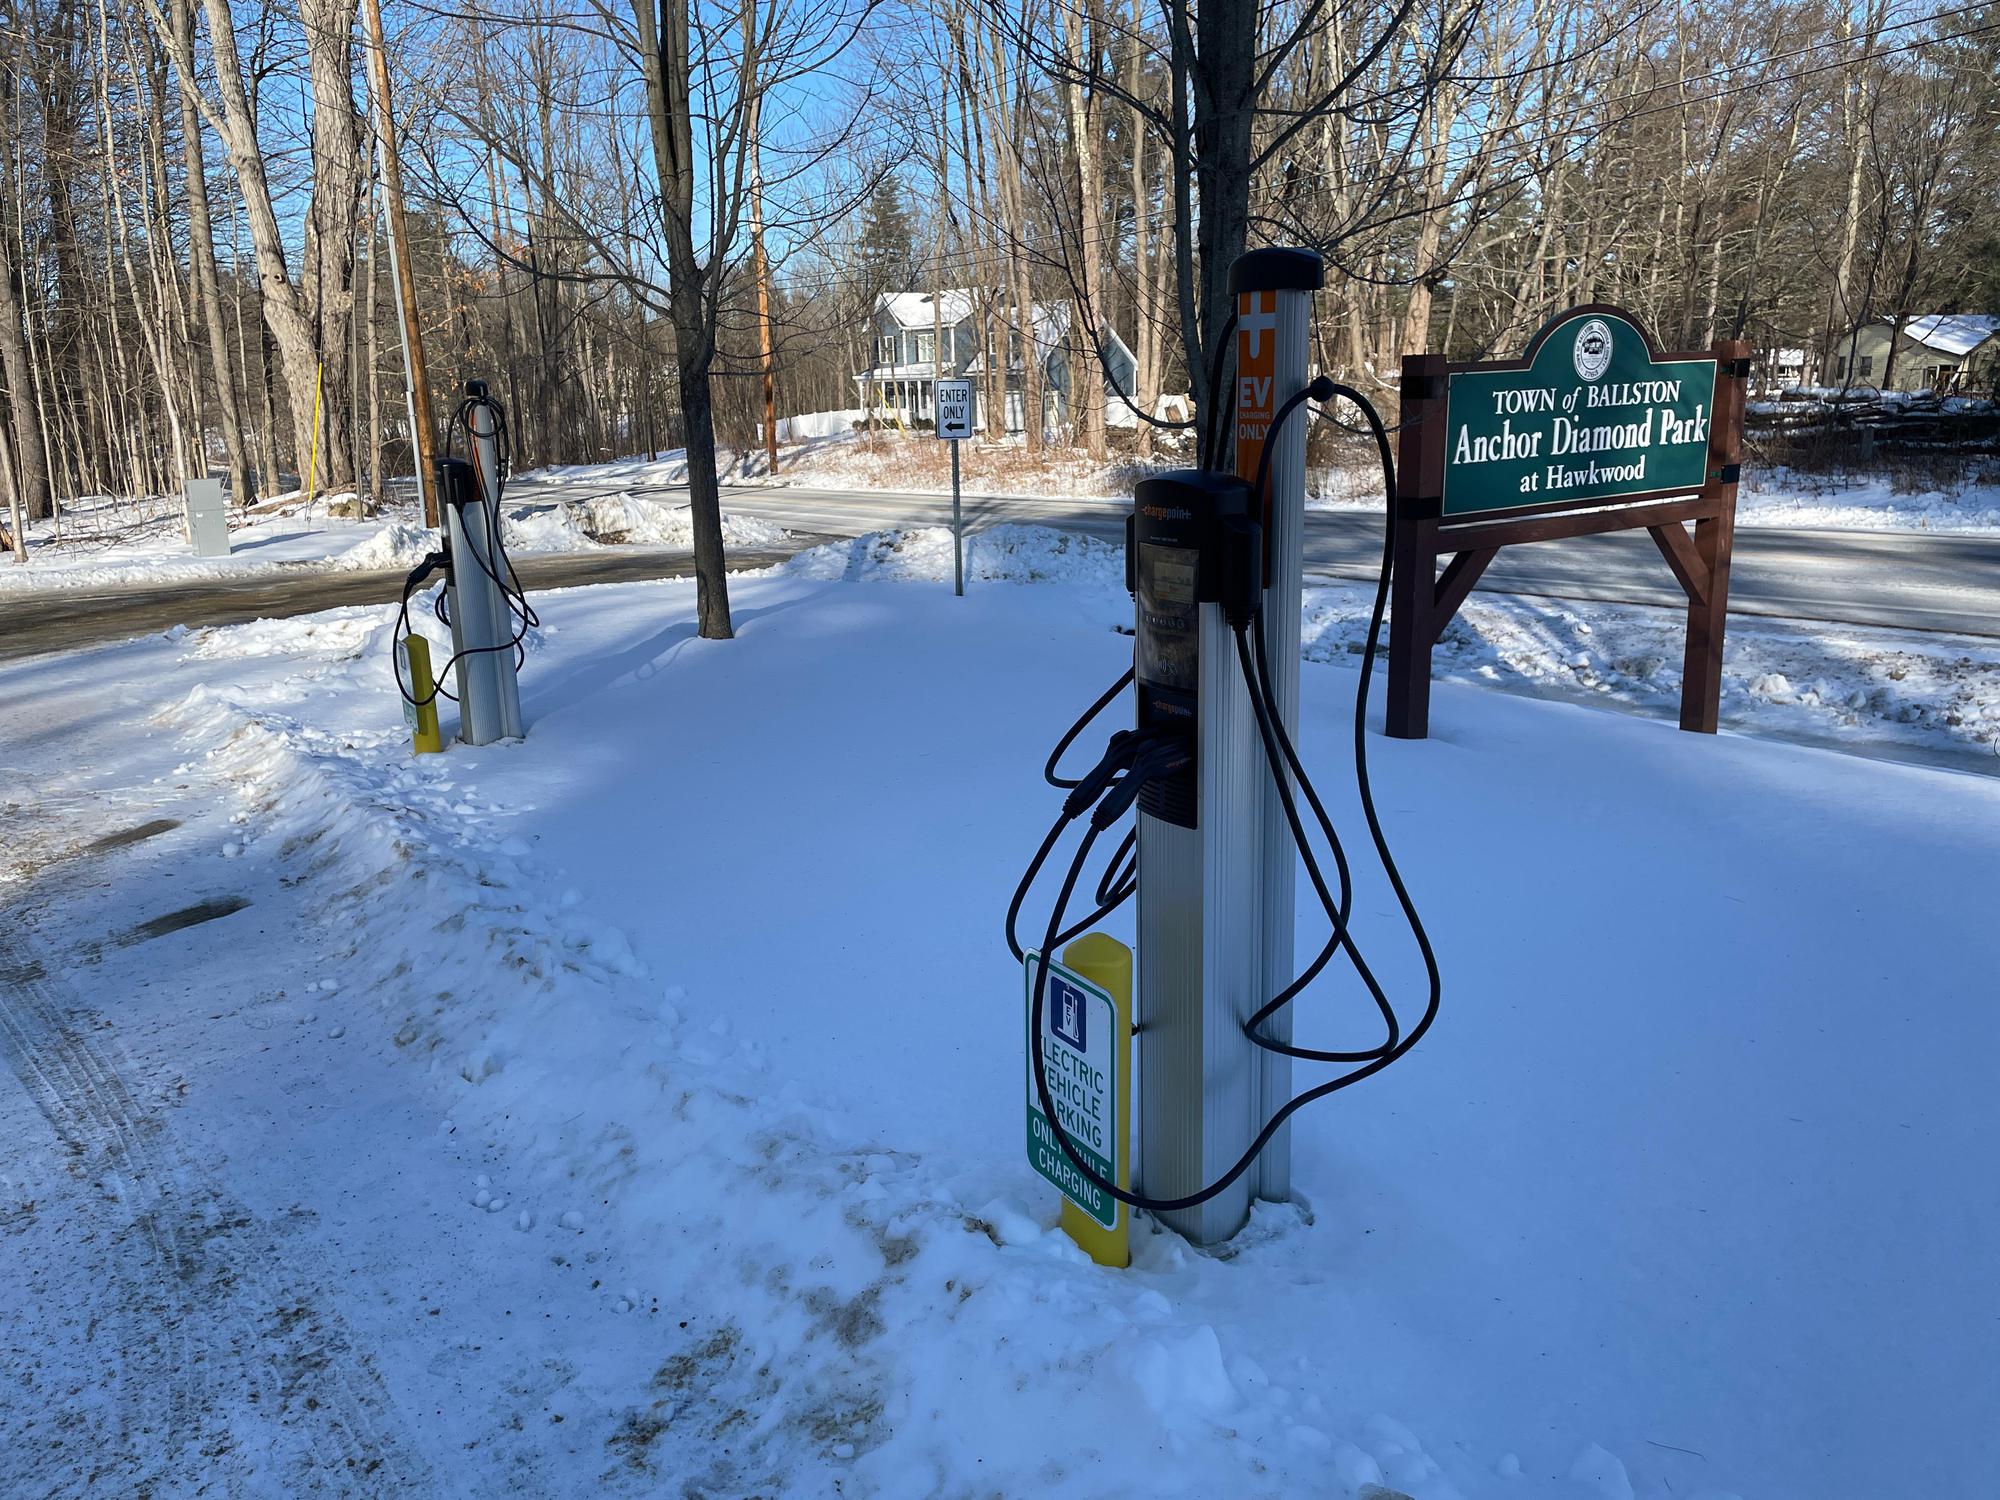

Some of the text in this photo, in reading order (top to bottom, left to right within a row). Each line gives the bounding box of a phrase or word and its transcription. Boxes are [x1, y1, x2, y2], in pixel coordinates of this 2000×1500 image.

[940, 389, 968, 402] ENTER
[1239, 376, 1272, 408] EV
[1493, 380, 1682, 414] TOWN of BALLSTON
[943, 406, 965, 419] ONLY
[1239, 411, 1271, 420] CHARGING
[1239, 423, 1272, 441] ONLY
[1452, 404, 1708, 465] Anchor Diamond Park
[1519, 455, 1645, 493] at Hawkwood
[1041, 1036, 1104, 1095] LECTRIC
[1038, 1147, 1101, 1210] CHARGING
